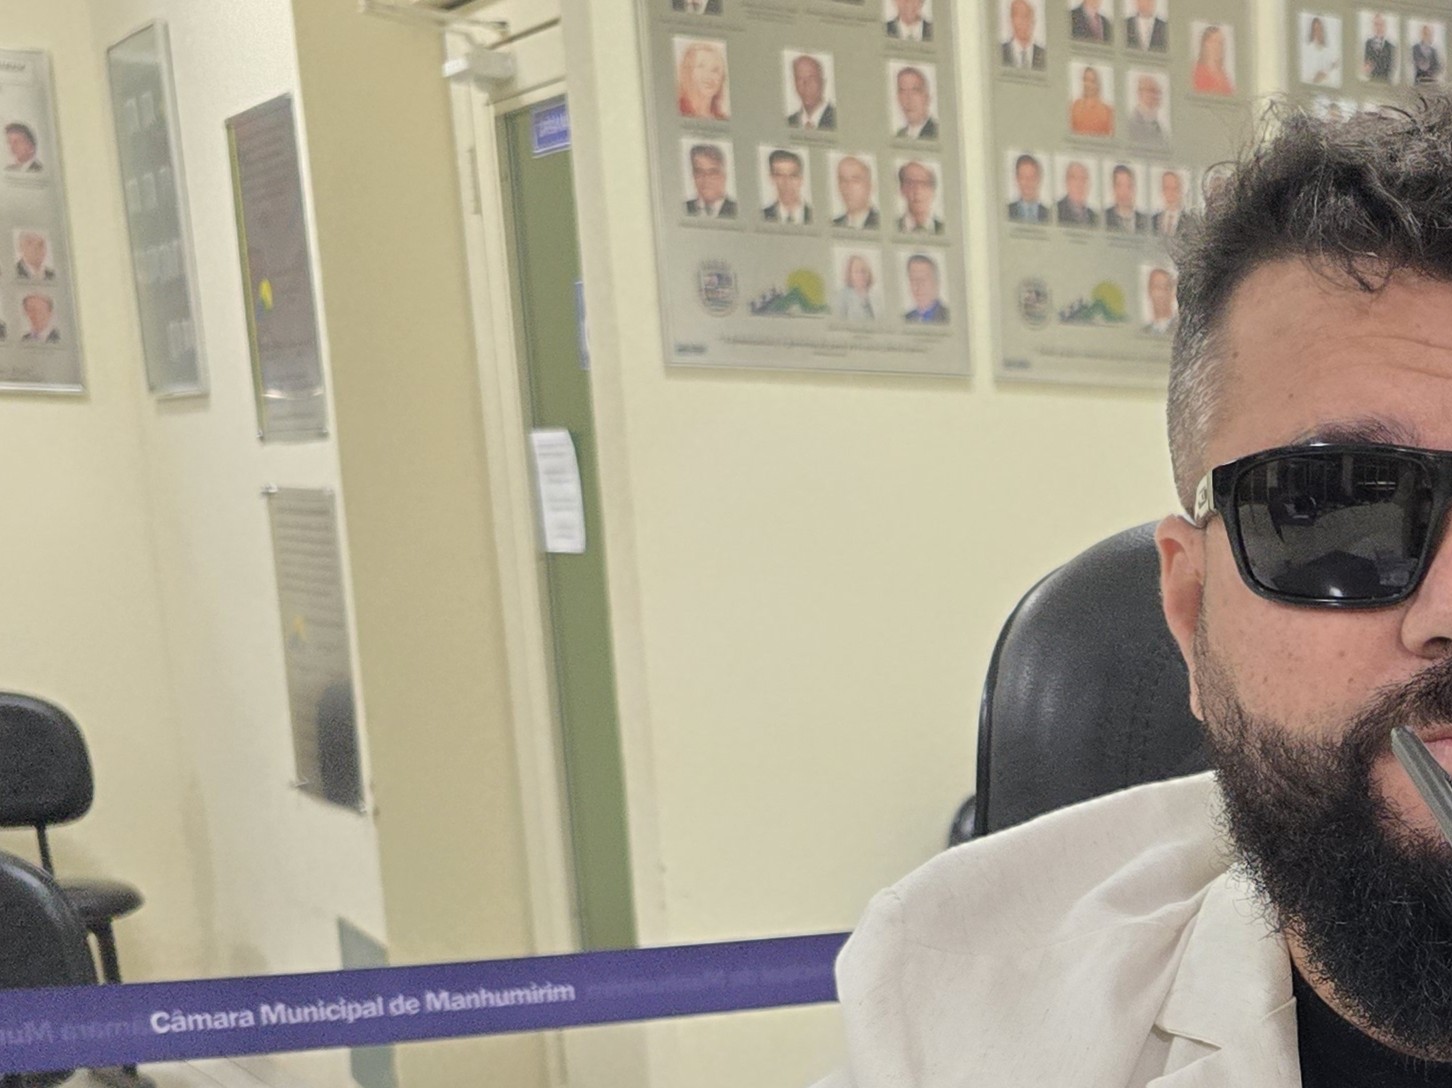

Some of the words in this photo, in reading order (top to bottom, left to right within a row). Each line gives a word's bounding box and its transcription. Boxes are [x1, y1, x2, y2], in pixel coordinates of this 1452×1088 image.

[150, 1007, 255, 1034] Câmara
[260, 995, 384, 1025] Municipal
[389, 992, 420, 1016] de
[424, 981, 576, 1012] Manhumirim
